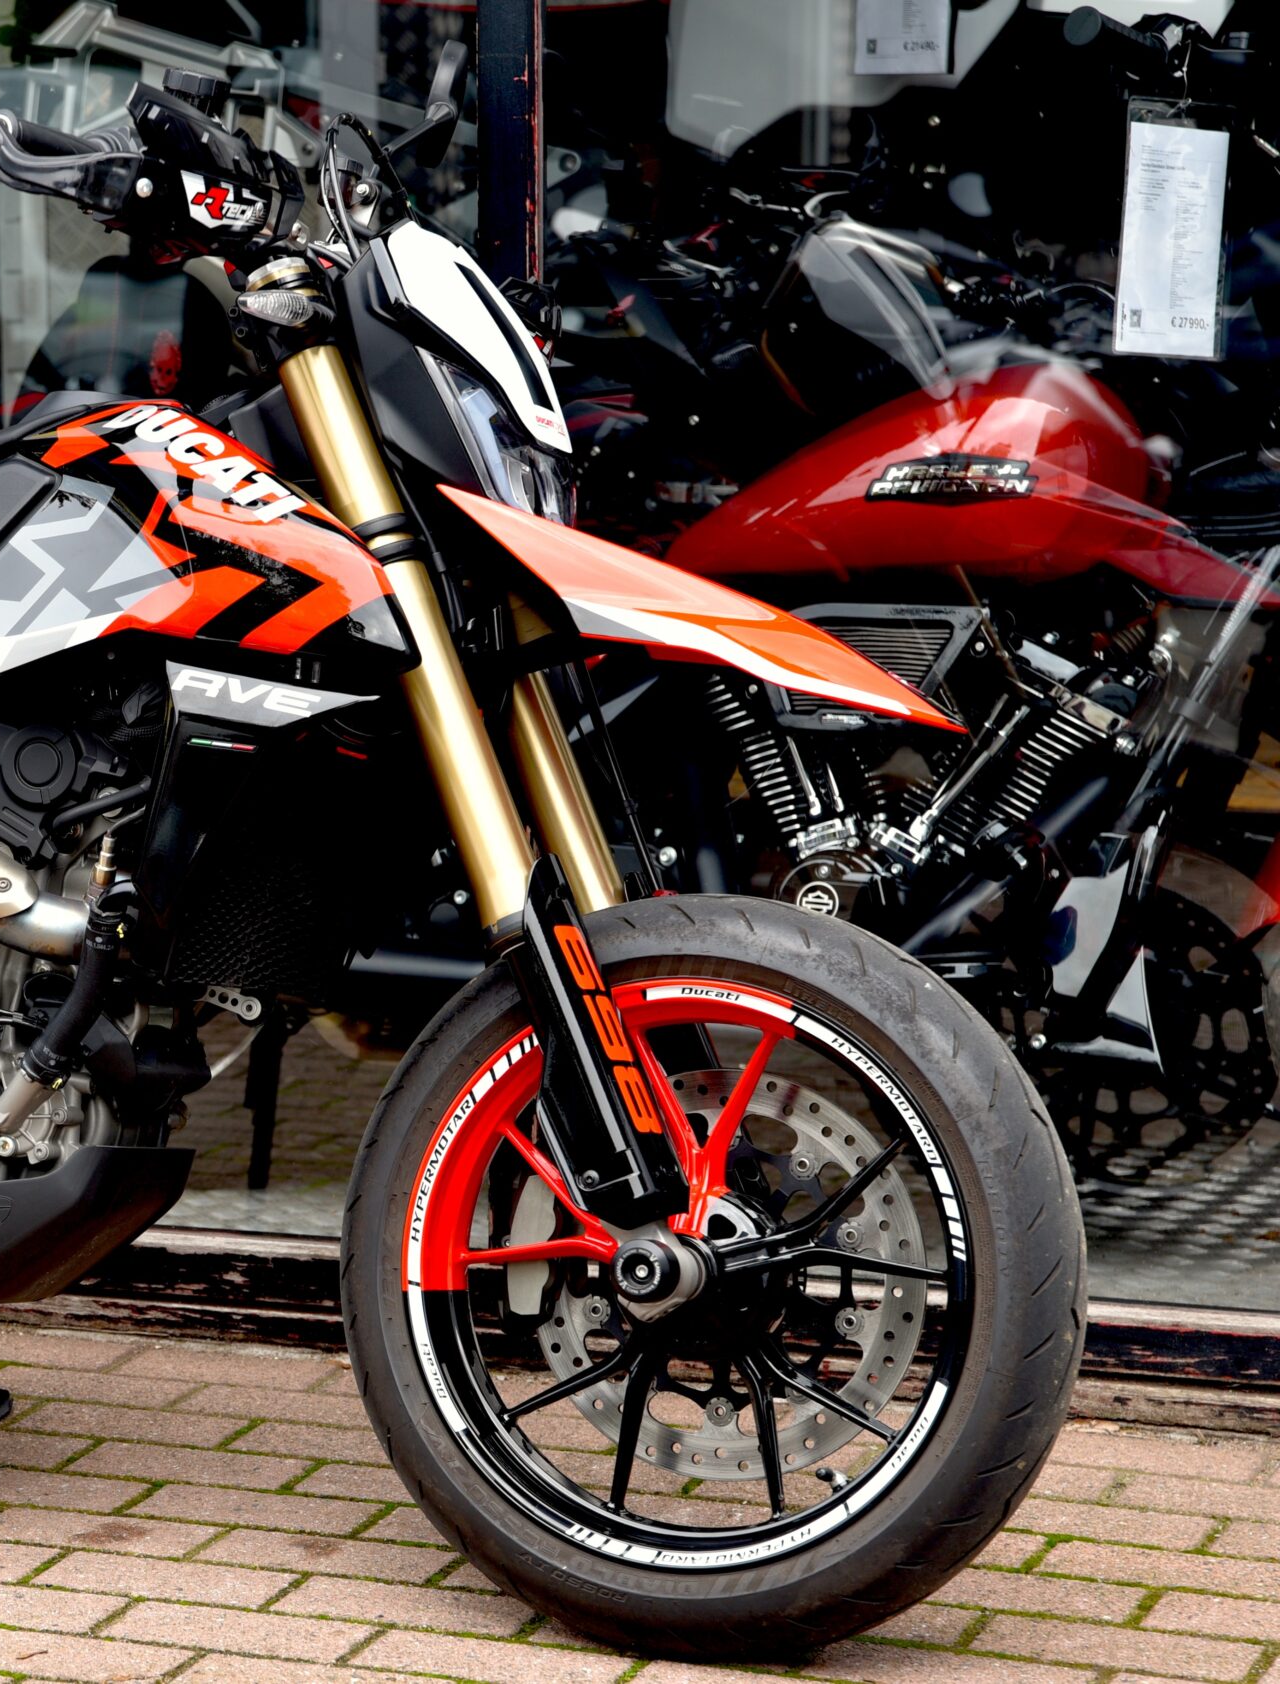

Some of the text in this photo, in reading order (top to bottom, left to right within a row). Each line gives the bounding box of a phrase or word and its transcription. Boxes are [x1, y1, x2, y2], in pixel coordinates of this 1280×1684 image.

[102, 404, 307, 524] DUCATI
[553, 924, 662, 1135] 698
[680, 986, 741, 1002] Ducati
[830, 1036, 939, 1164] HYPERMOTARD
[420, 1343, 447, 1398] Ducati
[661, 1527, 812, 1565] HYPERMOTARD
